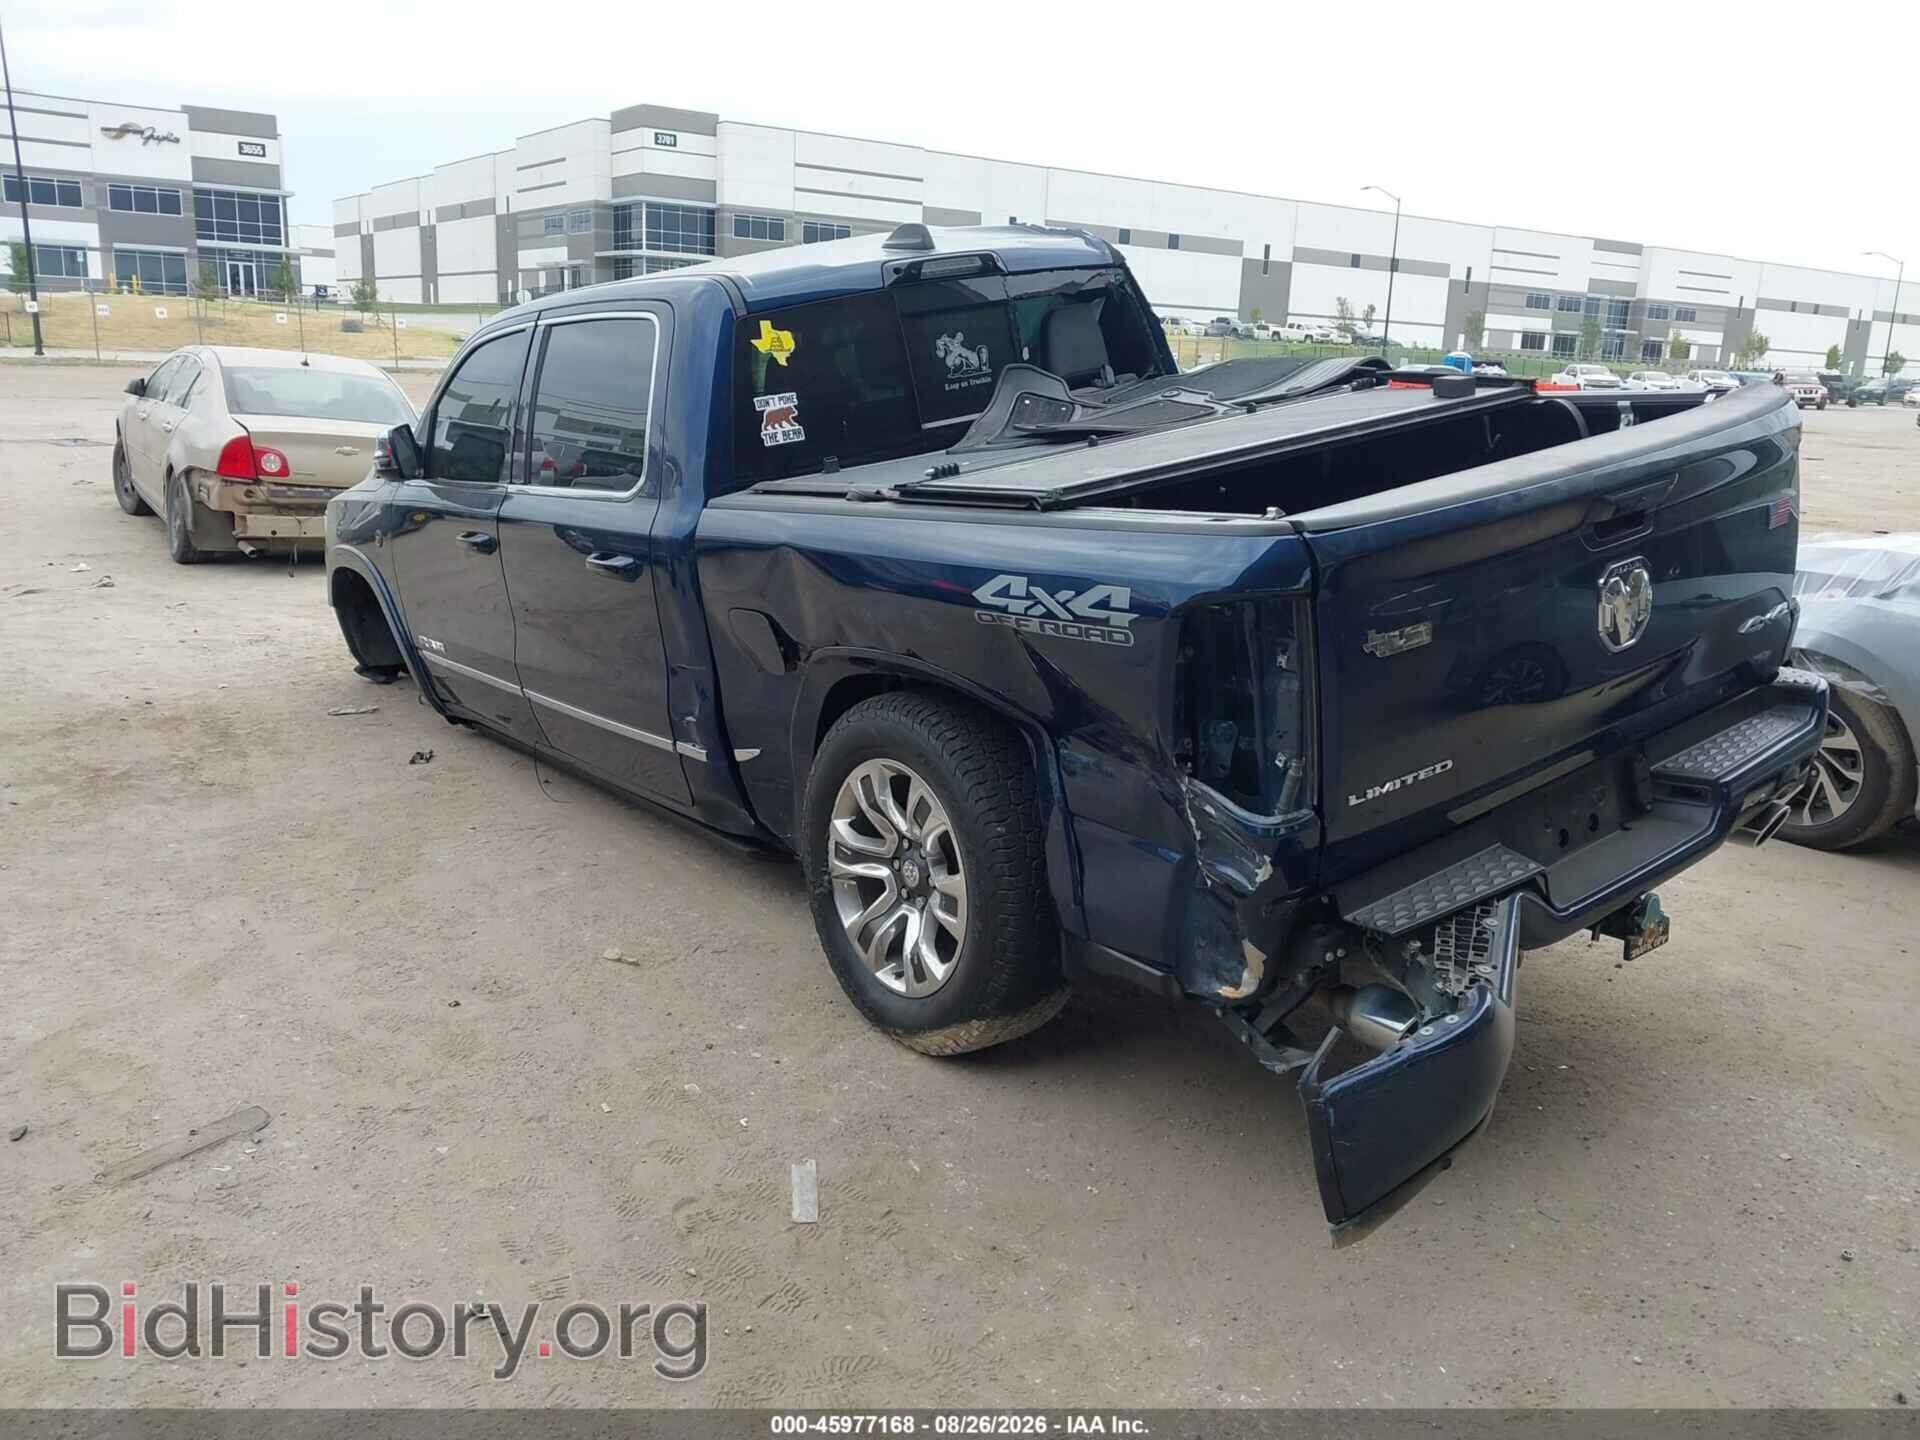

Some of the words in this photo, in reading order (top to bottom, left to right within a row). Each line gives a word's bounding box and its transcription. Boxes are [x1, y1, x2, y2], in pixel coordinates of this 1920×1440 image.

[762, 431, 780, 445] THE
[781, 427, 804, 441] BEAR
[975, 611, 1035, 632] OFF
[1038, 620, 1133, 646] ROAD
[1348, 760, 1453, 806] LIMITED
